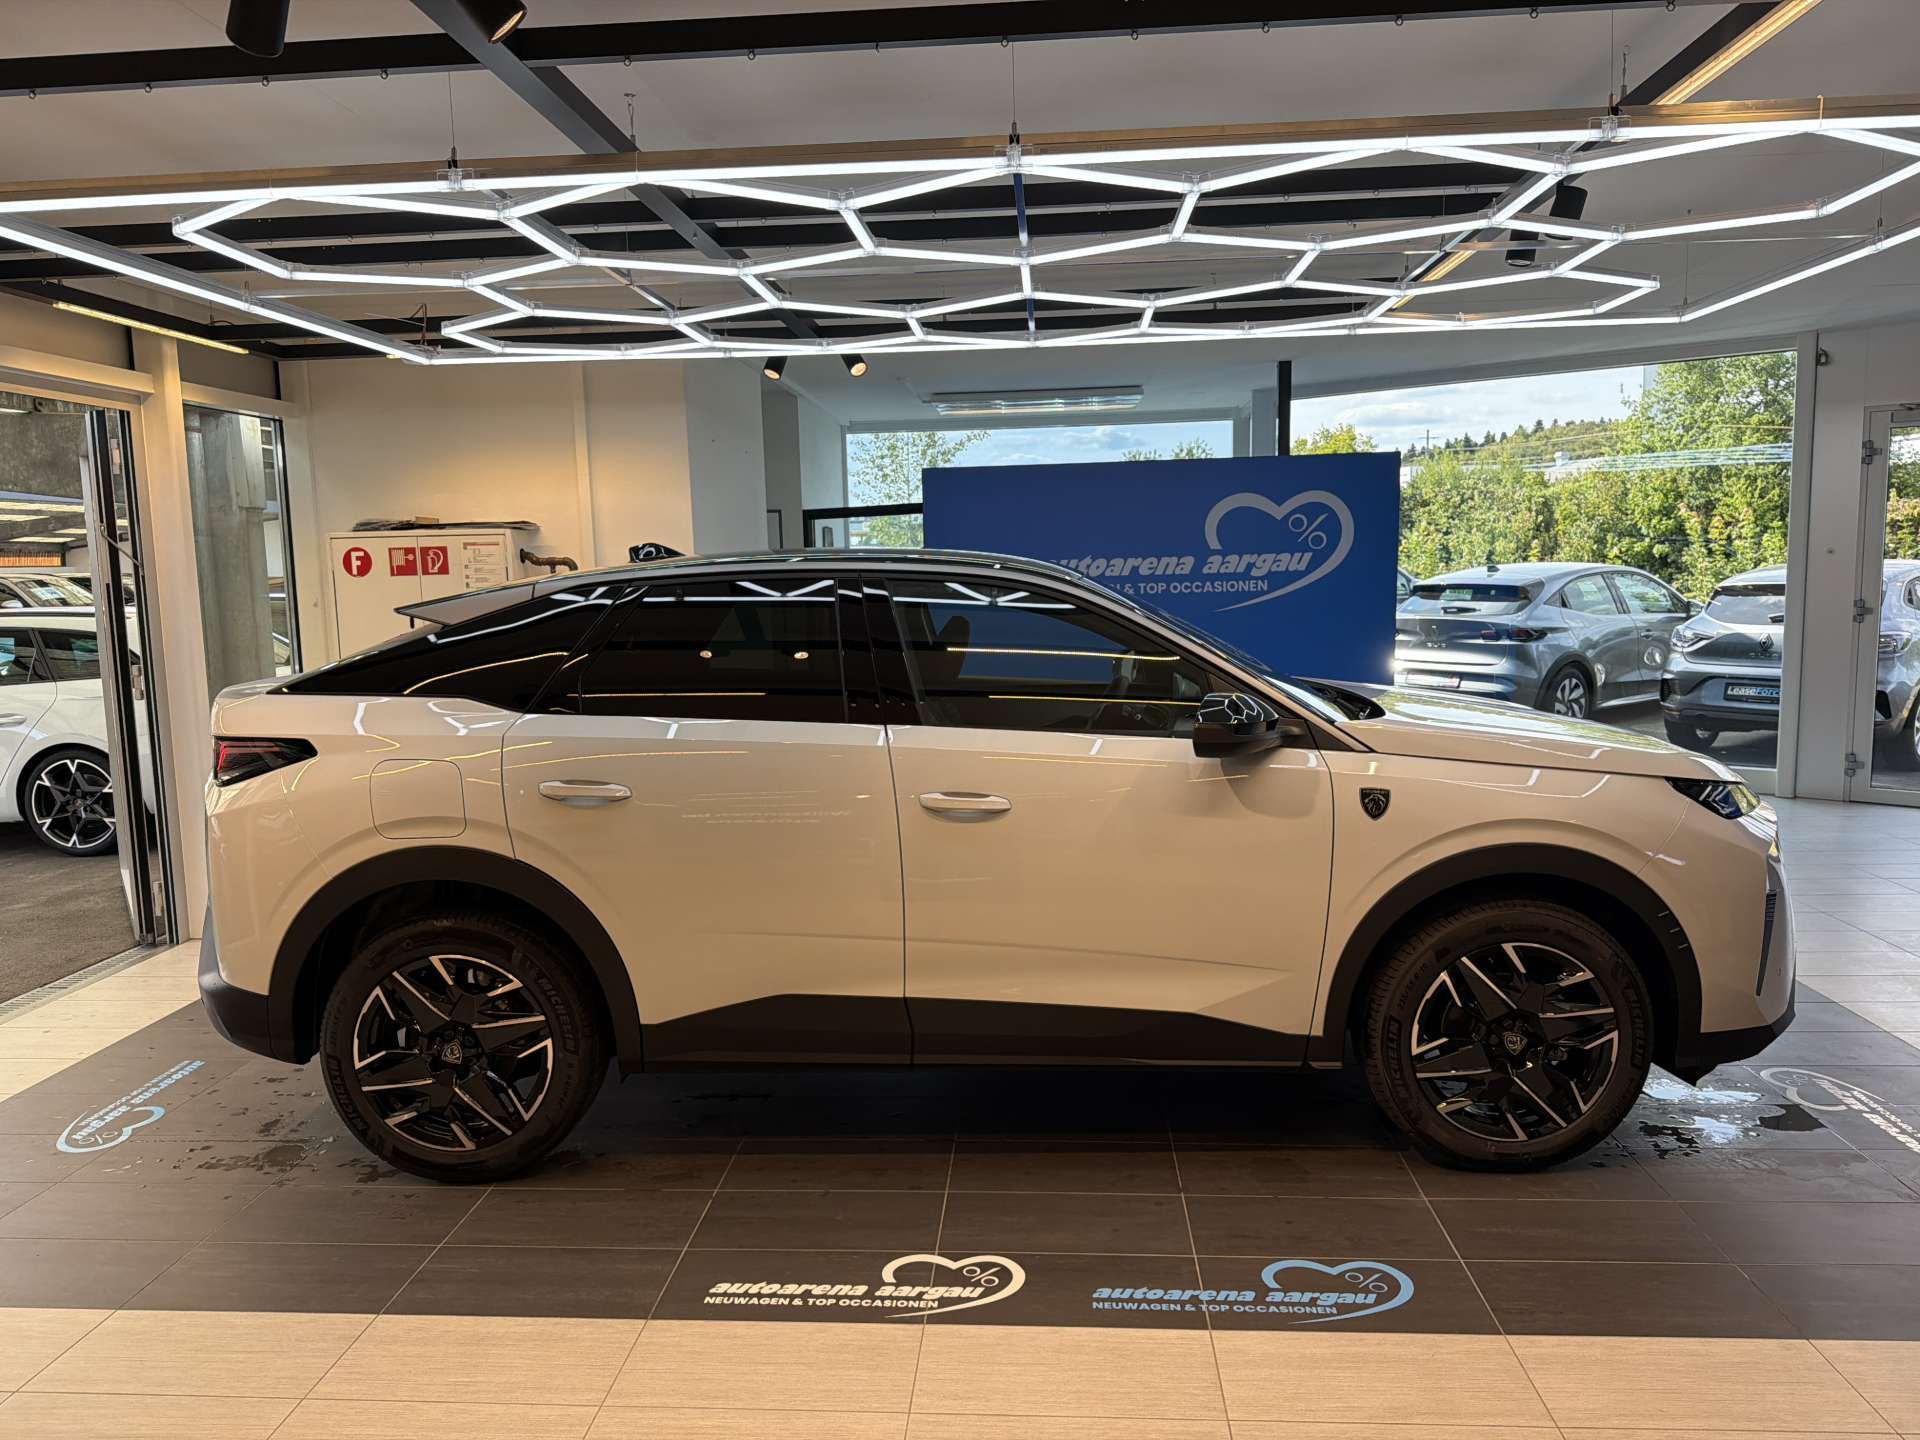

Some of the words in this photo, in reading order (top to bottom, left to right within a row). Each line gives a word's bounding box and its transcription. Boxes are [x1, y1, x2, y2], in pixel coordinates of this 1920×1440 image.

[350, 551, 365, 576] F
[1049, 555, 1195, 577] toarena
[1202, 552, 1313, 577] aargau
[1124, 583, 1135, 595] &
[1138, 582, 1167, 594] TOP
[1170, 580, 1268, 594] OCCASIONEN
[709, 1281, 869, 1296] autoarena
[874, 1286, 985, 1300] aargau
[1092, 1286, 1256, 1301] autoarena
[1265, 1291, 1377, 1305] aargau
[704, 1296, 789, 1305] NEUWAGEN
[792, 1298, 803, 1306] &
[807, 1298, 837, 1306] TOP
[839, 1298, 939, 1308] OCCASIONEN
[1092, 1302, 1181, 1311] NEUWAGEN
[1184, 1303, 1196, 1311] &
[1200, 1303, 1230, 1312] TOP
[1233, 1304, 1338, 1314] OCCASIONEN
